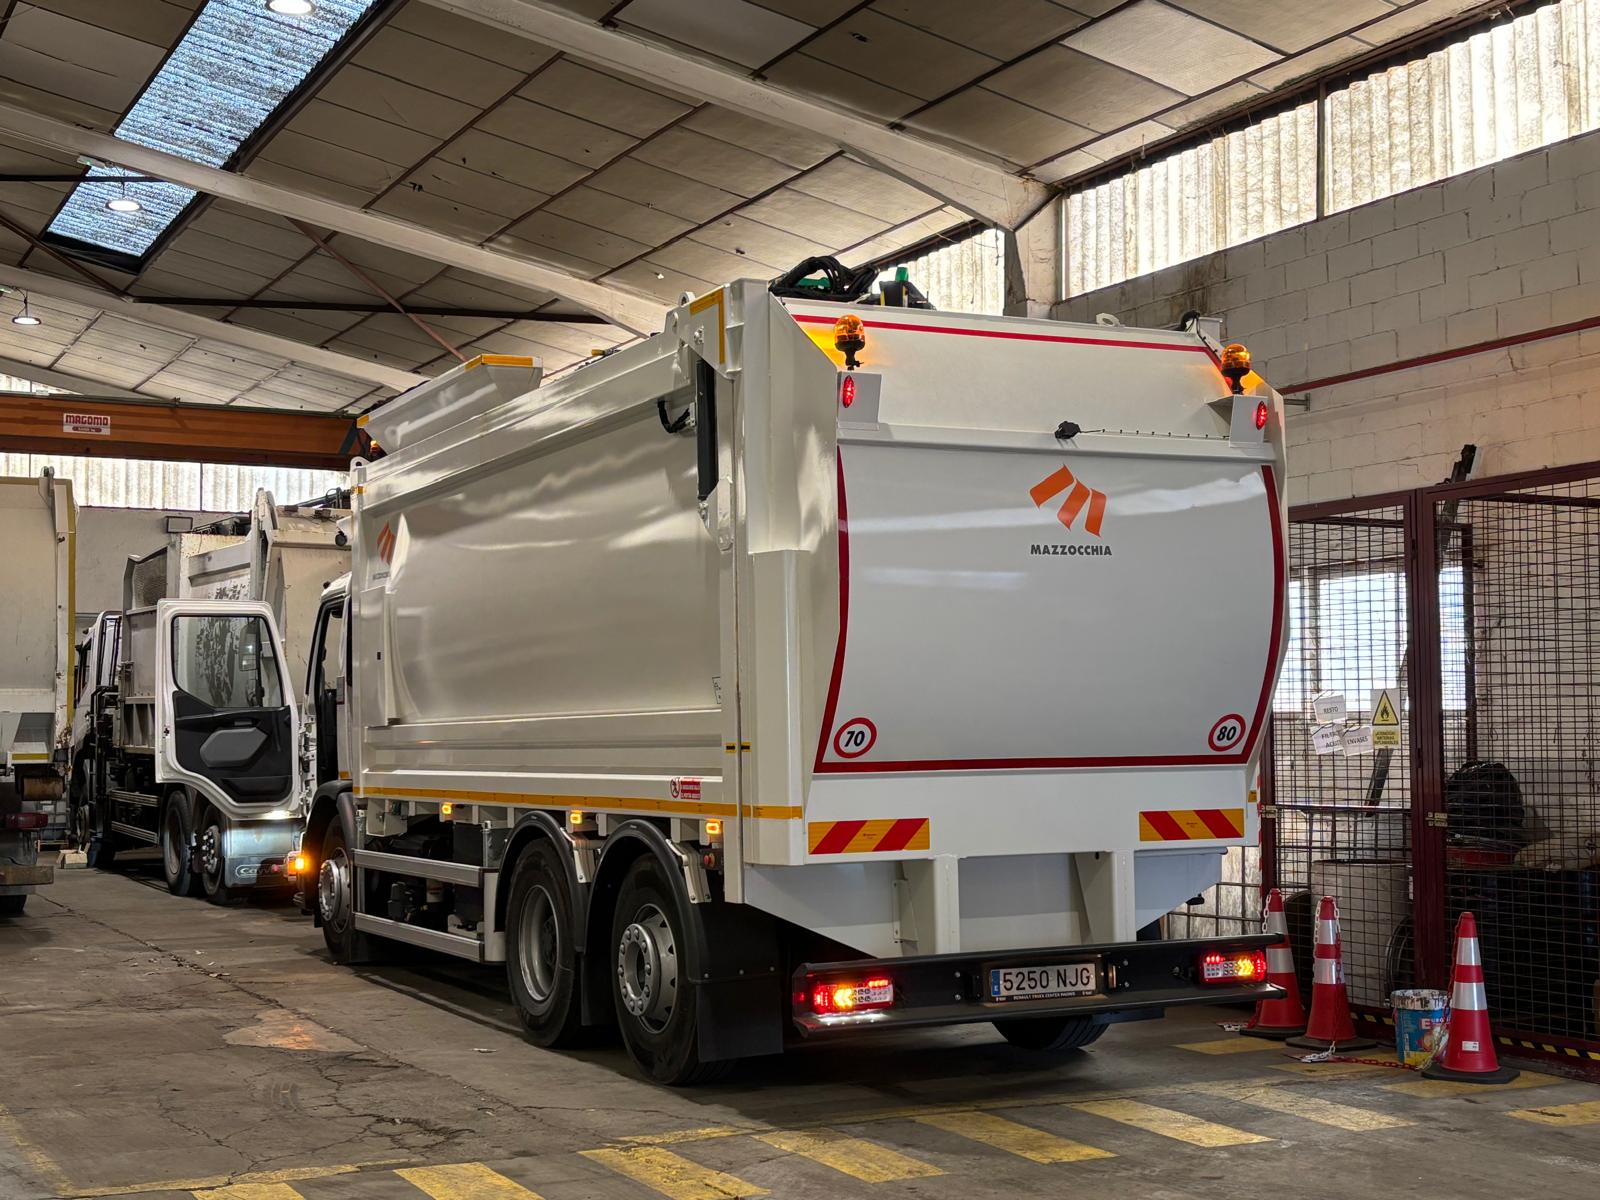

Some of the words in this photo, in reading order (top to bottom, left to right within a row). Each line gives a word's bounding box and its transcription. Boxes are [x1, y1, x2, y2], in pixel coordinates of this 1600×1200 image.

[1030, 544, 1112, 556] MAZZOCCHIA
[1323, 706, 1338, 714] RESTO
[844, 730, 866, 747] 70
[1216, 725, 1237, 742] 80
[1347, 735, 1368, 745] ENVASES
[1003, 969, 1049, 991] 5250
[1056, 967, 1090, 988] NJG
